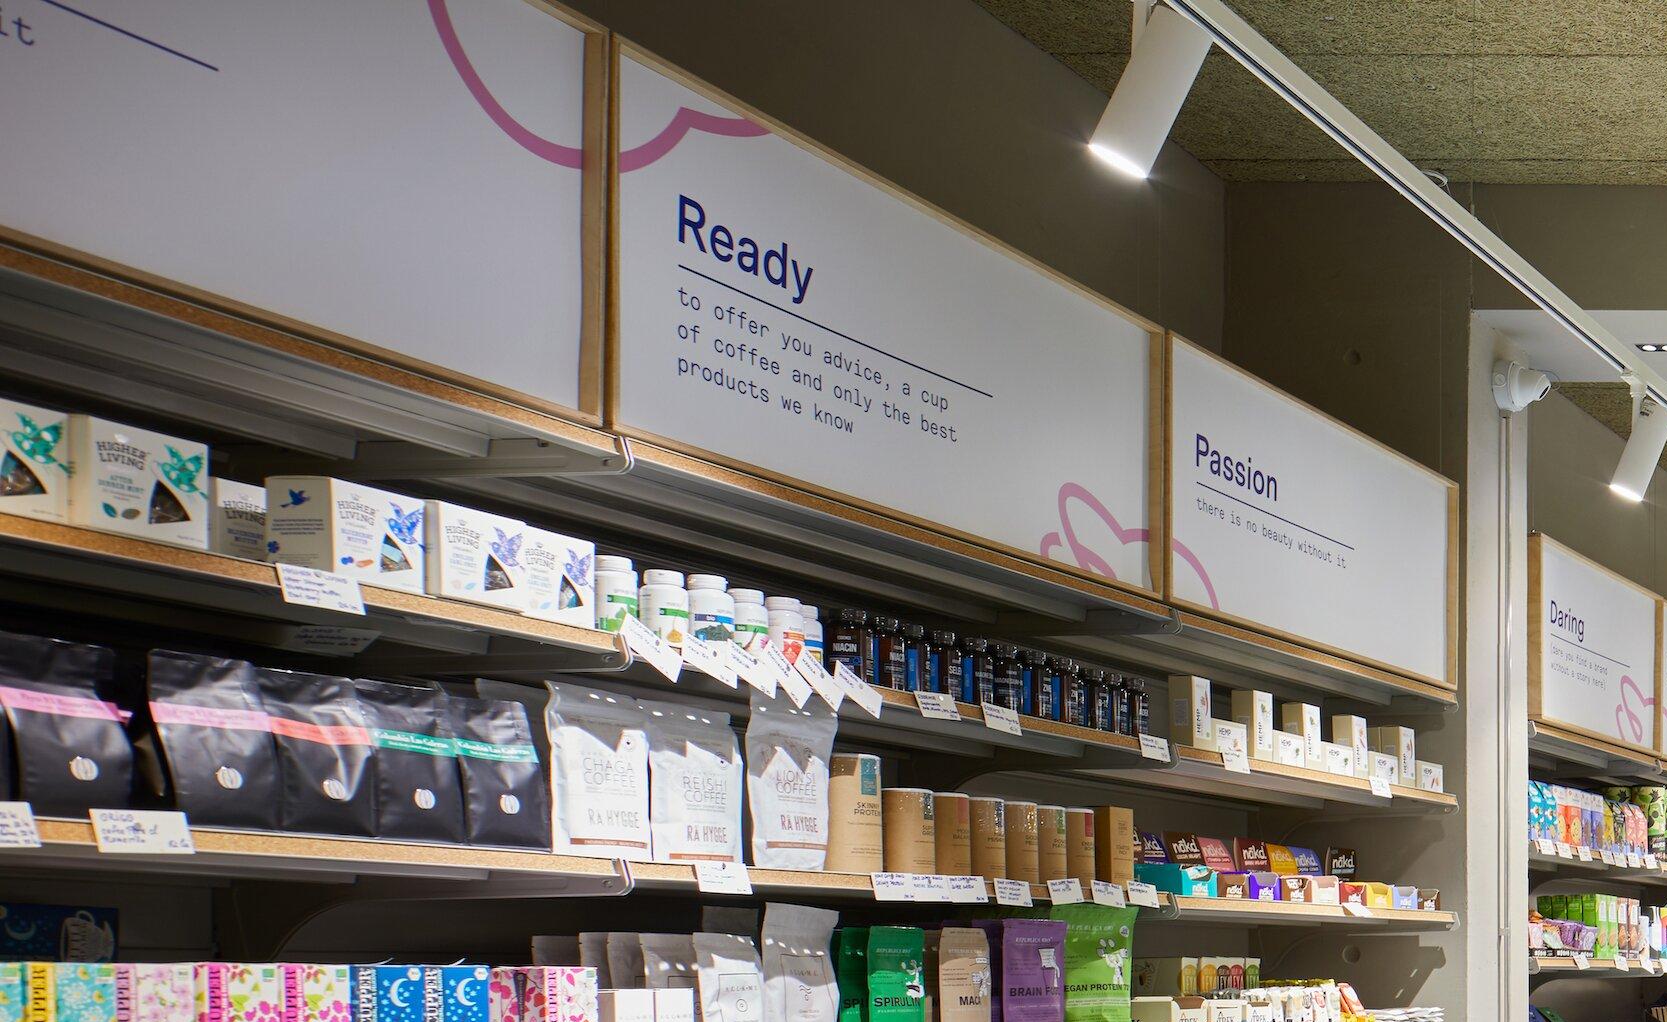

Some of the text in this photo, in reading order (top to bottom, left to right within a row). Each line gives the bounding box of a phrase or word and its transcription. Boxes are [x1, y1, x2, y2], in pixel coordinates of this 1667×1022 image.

[678, 194, 813, 304] Ready
[678, 287, 949, 412] to offer you advice, a cup
[677, 324, 957, 443] of coffee and only the best
[678, 356, 854, 434] products we know
[96, 441, 147, 462] HIGHER
[99, 452, 145, 471] LIVING
[1196, 433, 1278, 501] Passion
[337, 499, 376, 517] HIGHER
[339, 509, 375, 527] LIVING
[445, 524, 481, 541] HIGHER
[446, 533, 480, 550] LIVING
[1196, 497, 1346, 569] there is no beauty without it
[1550, 600, 1585, 642] Daring
[832, 643, 857, 653] NIACIN
[583, 757, 633, 772] CHAGA
[584, 771, 635, 788] COFFEE
[682, 776, 727, 792] REISHI
[684, 790, 727, 805] COFFEE
[776, 781, 817, 797] COFFEE
[607, 810, 640, 829] HYGGE
[795, 816, 818, 833] HYGGE
[703, 826, 727, 844] HYGGE
[1009, 987, 1042, 997] BRAIN
[1090, 983, 1121, 992] PROTEIN
